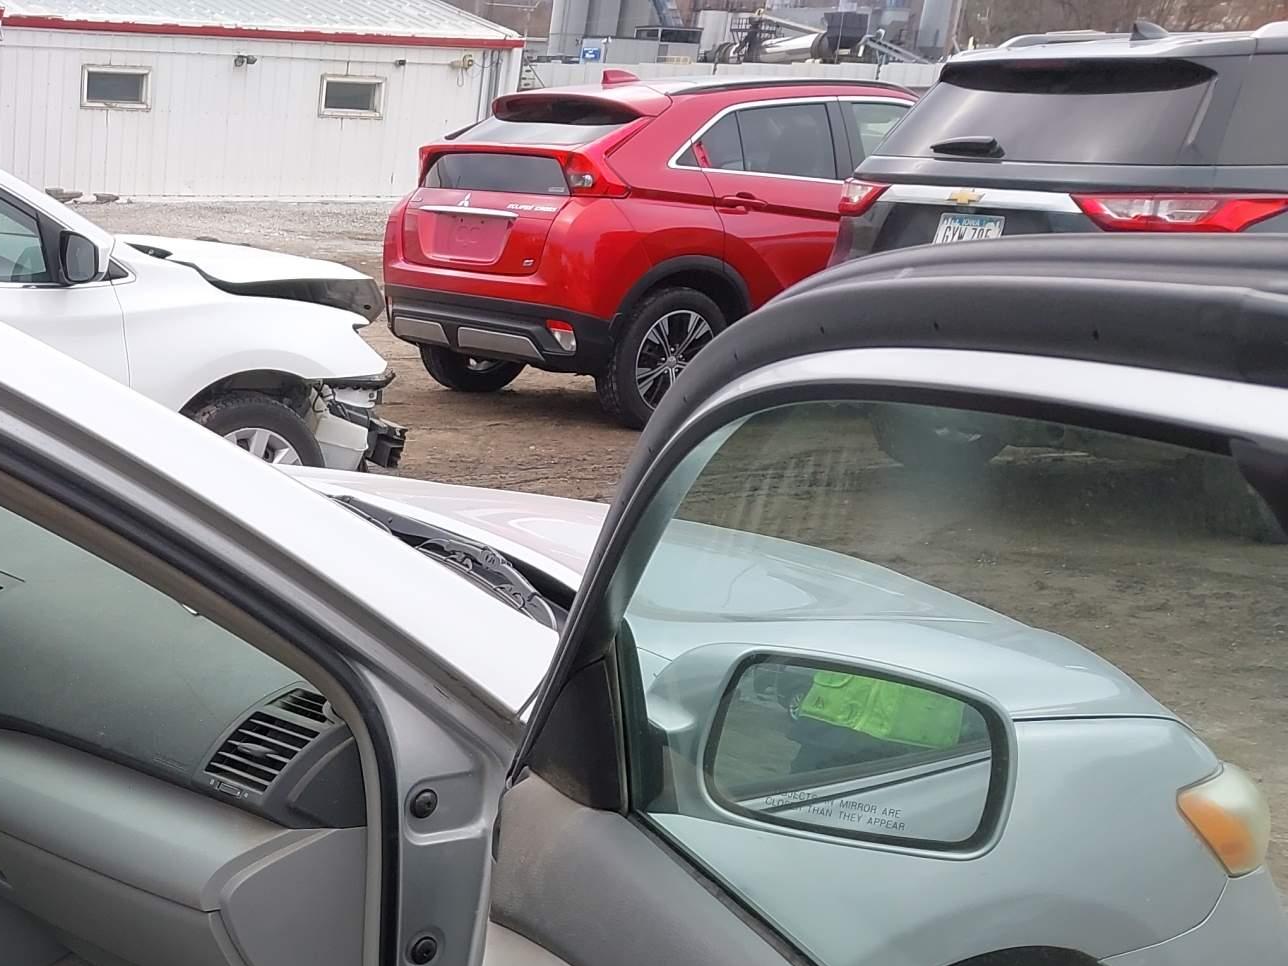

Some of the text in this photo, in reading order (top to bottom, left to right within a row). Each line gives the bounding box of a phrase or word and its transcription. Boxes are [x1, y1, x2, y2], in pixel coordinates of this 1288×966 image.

[807, 804, 834, 817] THAN
[838, 810, 864, 823] THEY
[866, 817, 906, 831] APPEAR
[839, 800, 878, 814] MIRROR
[881, 807, 902, 819] ARE
